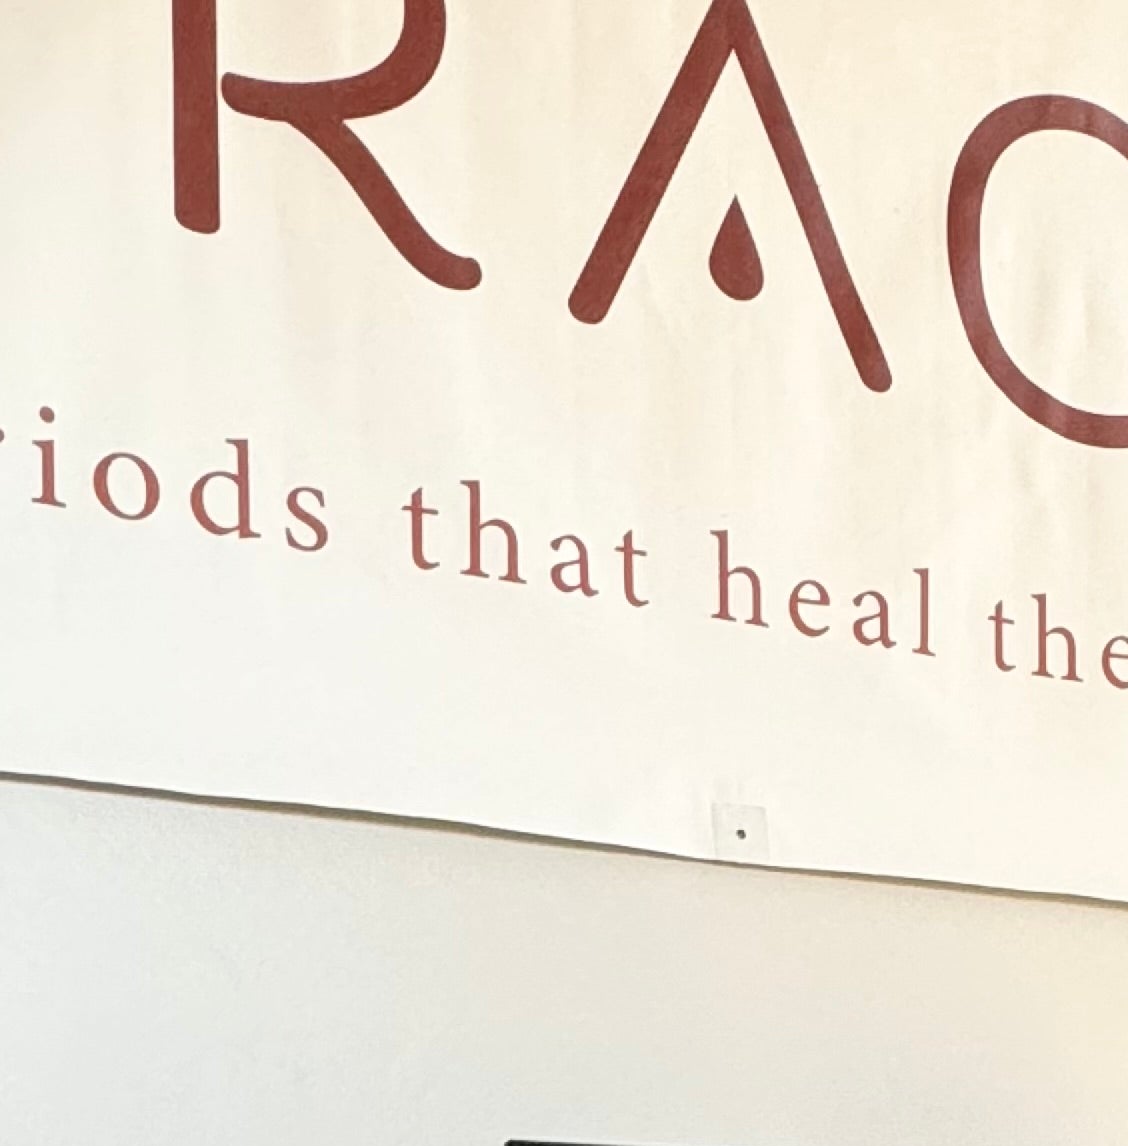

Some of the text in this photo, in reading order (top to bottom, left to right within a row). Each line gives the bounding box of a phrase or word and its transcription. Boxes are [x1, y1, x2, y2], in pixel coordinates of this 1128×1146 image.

[0, 405, 330, 552] iods
[402, 480, 649, 607] that
[710, 529, 937, 657] heal
